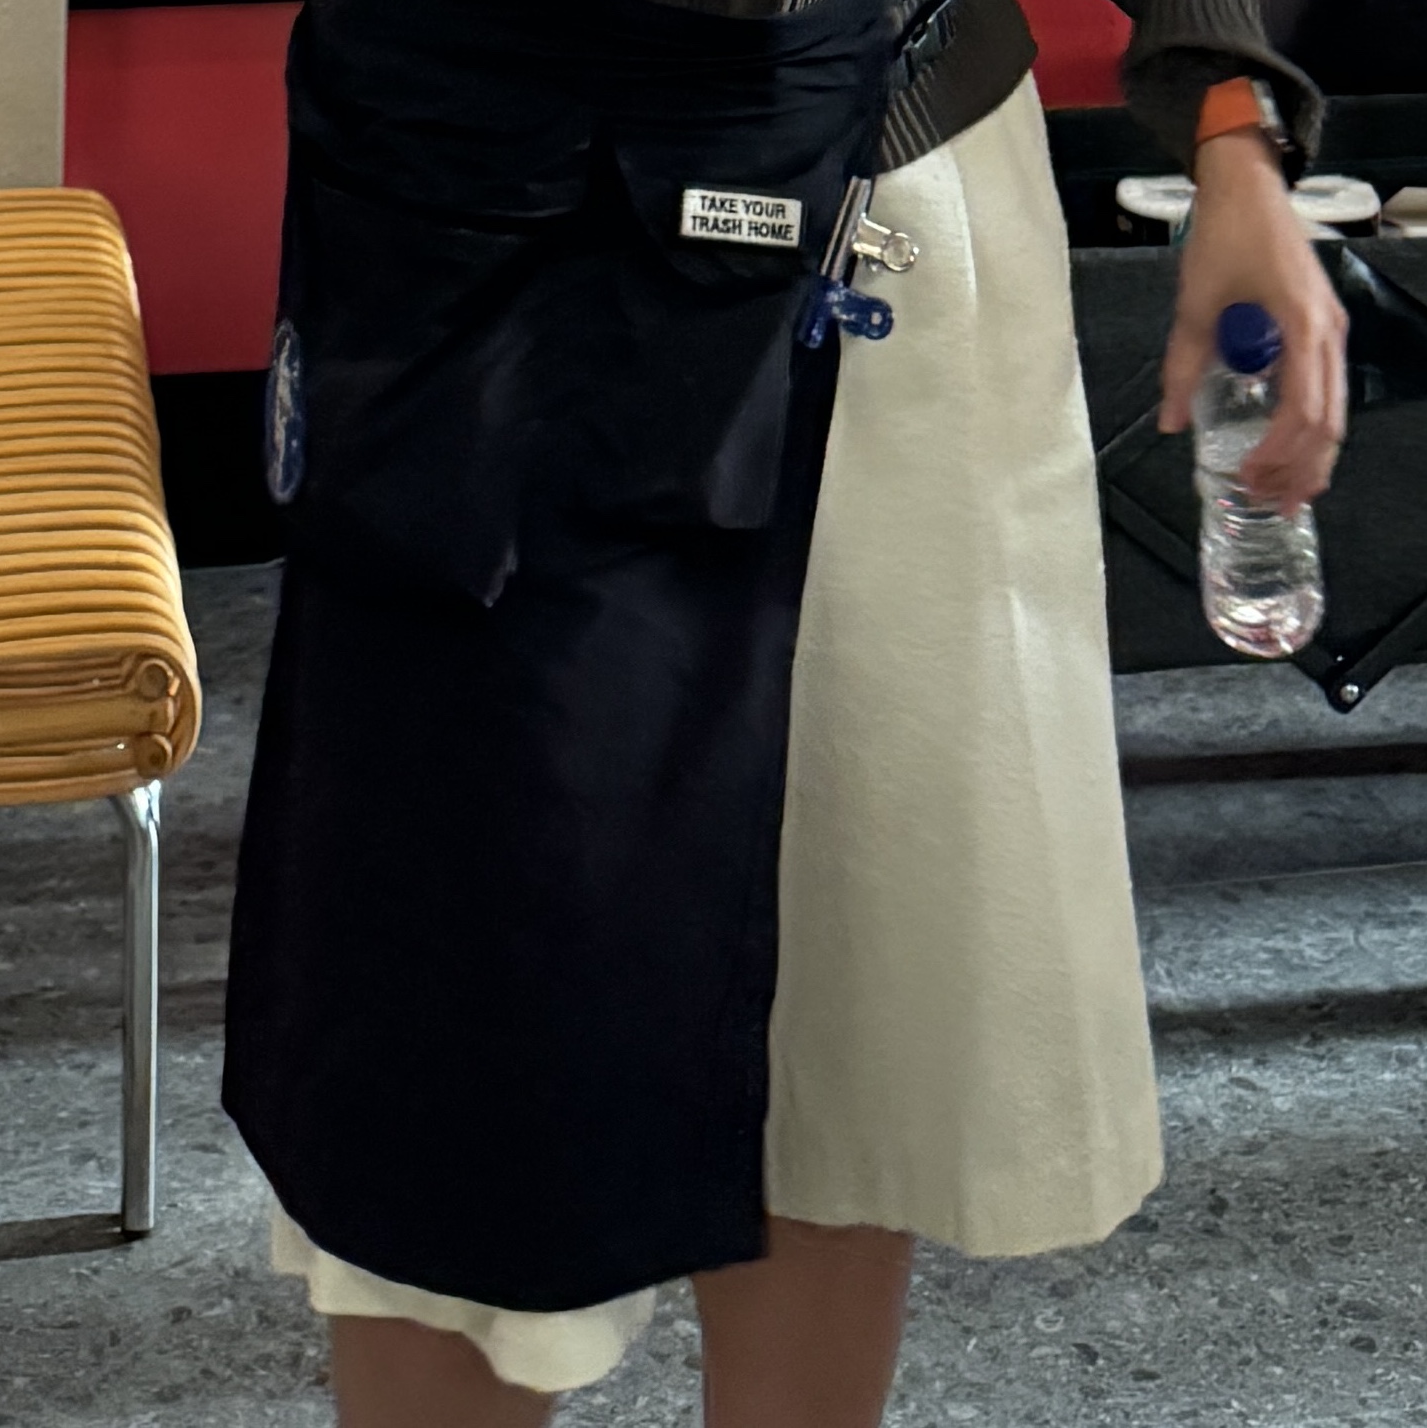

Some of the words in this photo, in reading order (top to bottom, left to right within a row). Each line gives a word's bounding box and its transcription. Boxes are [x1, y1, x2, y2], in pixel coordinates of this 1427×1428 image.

[699, 195, 739, 213] TAKE
[740, 199, 787, 219] YOUR
[691, 215, 742, 236] TRASH
[747, 221, 795, 242] HOME
